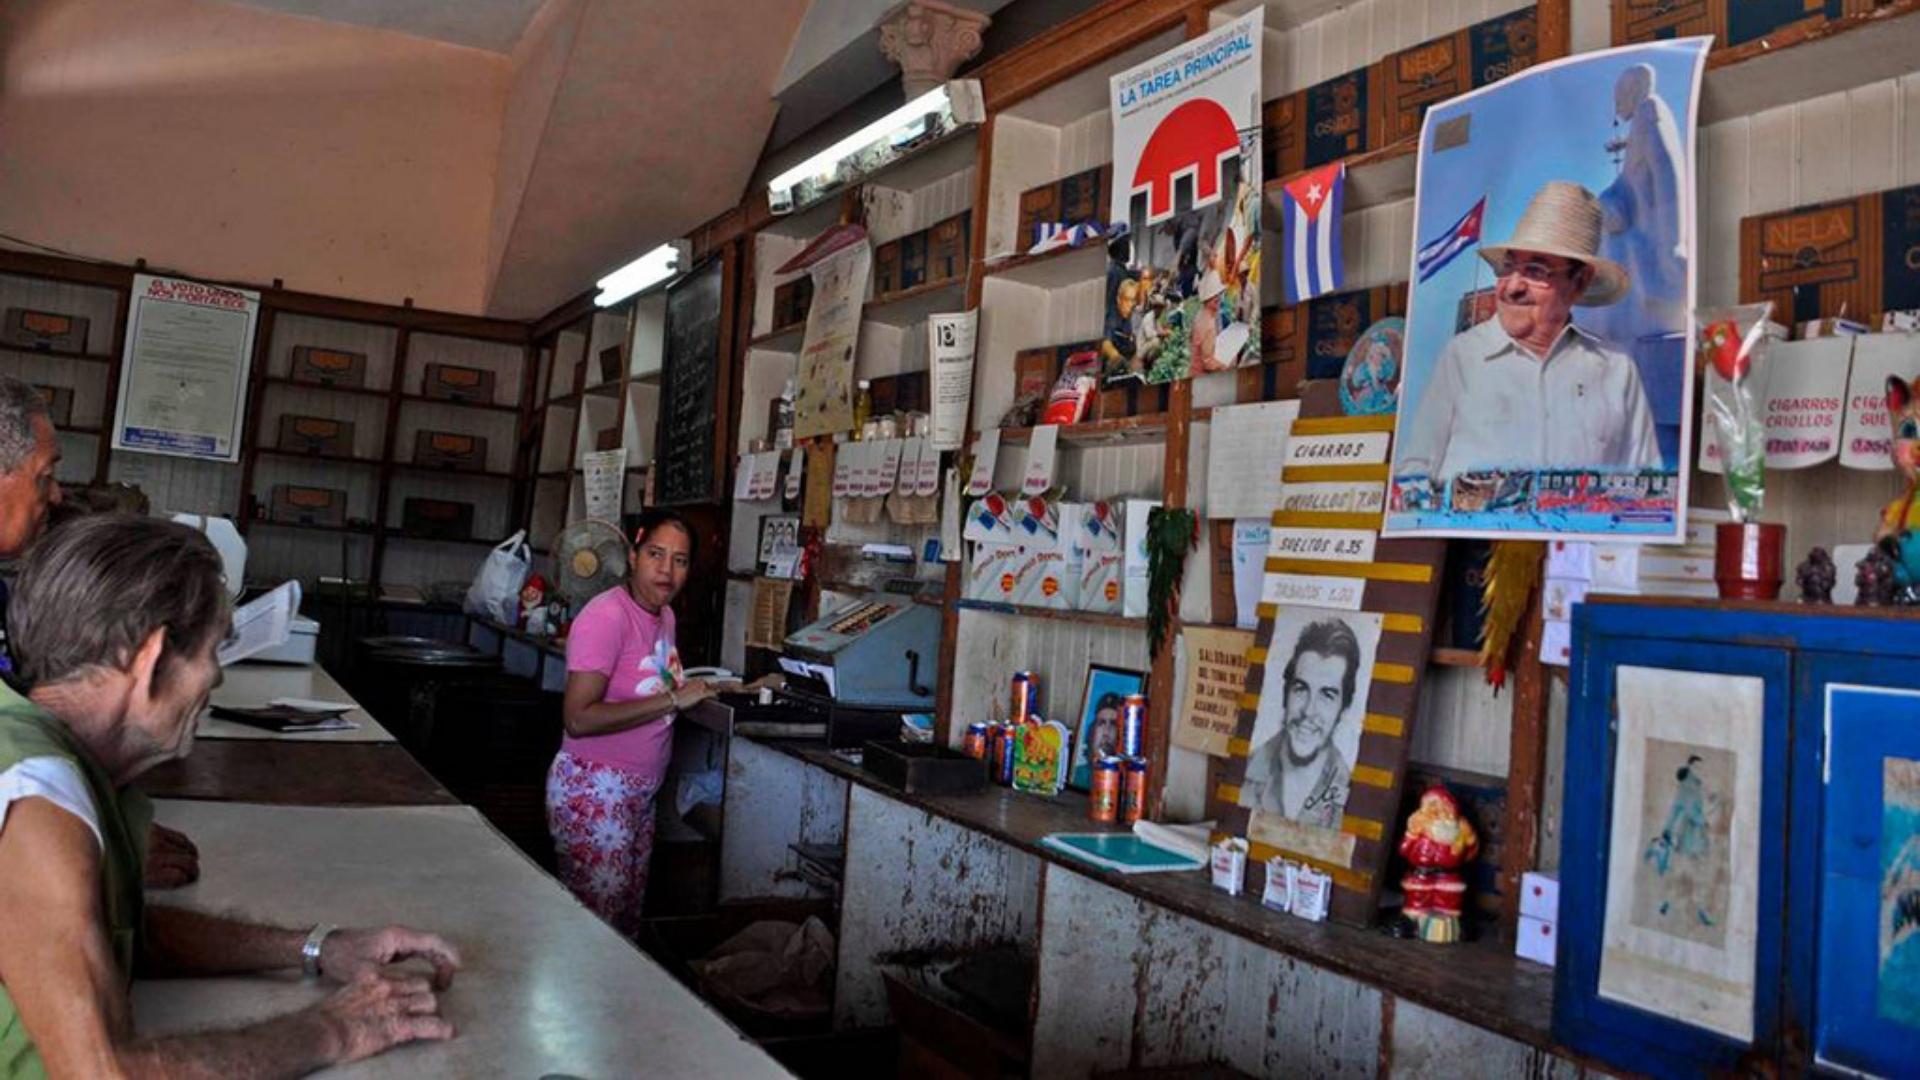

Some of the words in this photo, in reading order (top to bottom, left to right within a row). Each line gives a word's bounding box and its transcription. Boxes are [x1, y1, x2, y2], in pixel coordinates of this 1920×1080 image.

[1119, 88, 1137, 108] LA
[1139, 69, 1181, 98] TAREA
[1184, 34, 1254, 80] PRINCIPAL
[1769, 212, 1849, 244] NELA
[169, 281, 205, 294] VOTO
[1767, 396, 1841, 412] CIGARROS
[1851, 395, 1889, 411] CIGA
[1765, 414, 1834, 428] CRIOLLOS
[1859, 414, 1889, 426] SUE
[1293, 442, 1364, 459] CIGARROS
[1283, 491, 1349, 512] CRIOLLOS
[1279, 537, 1332, 553] SUELTOS
